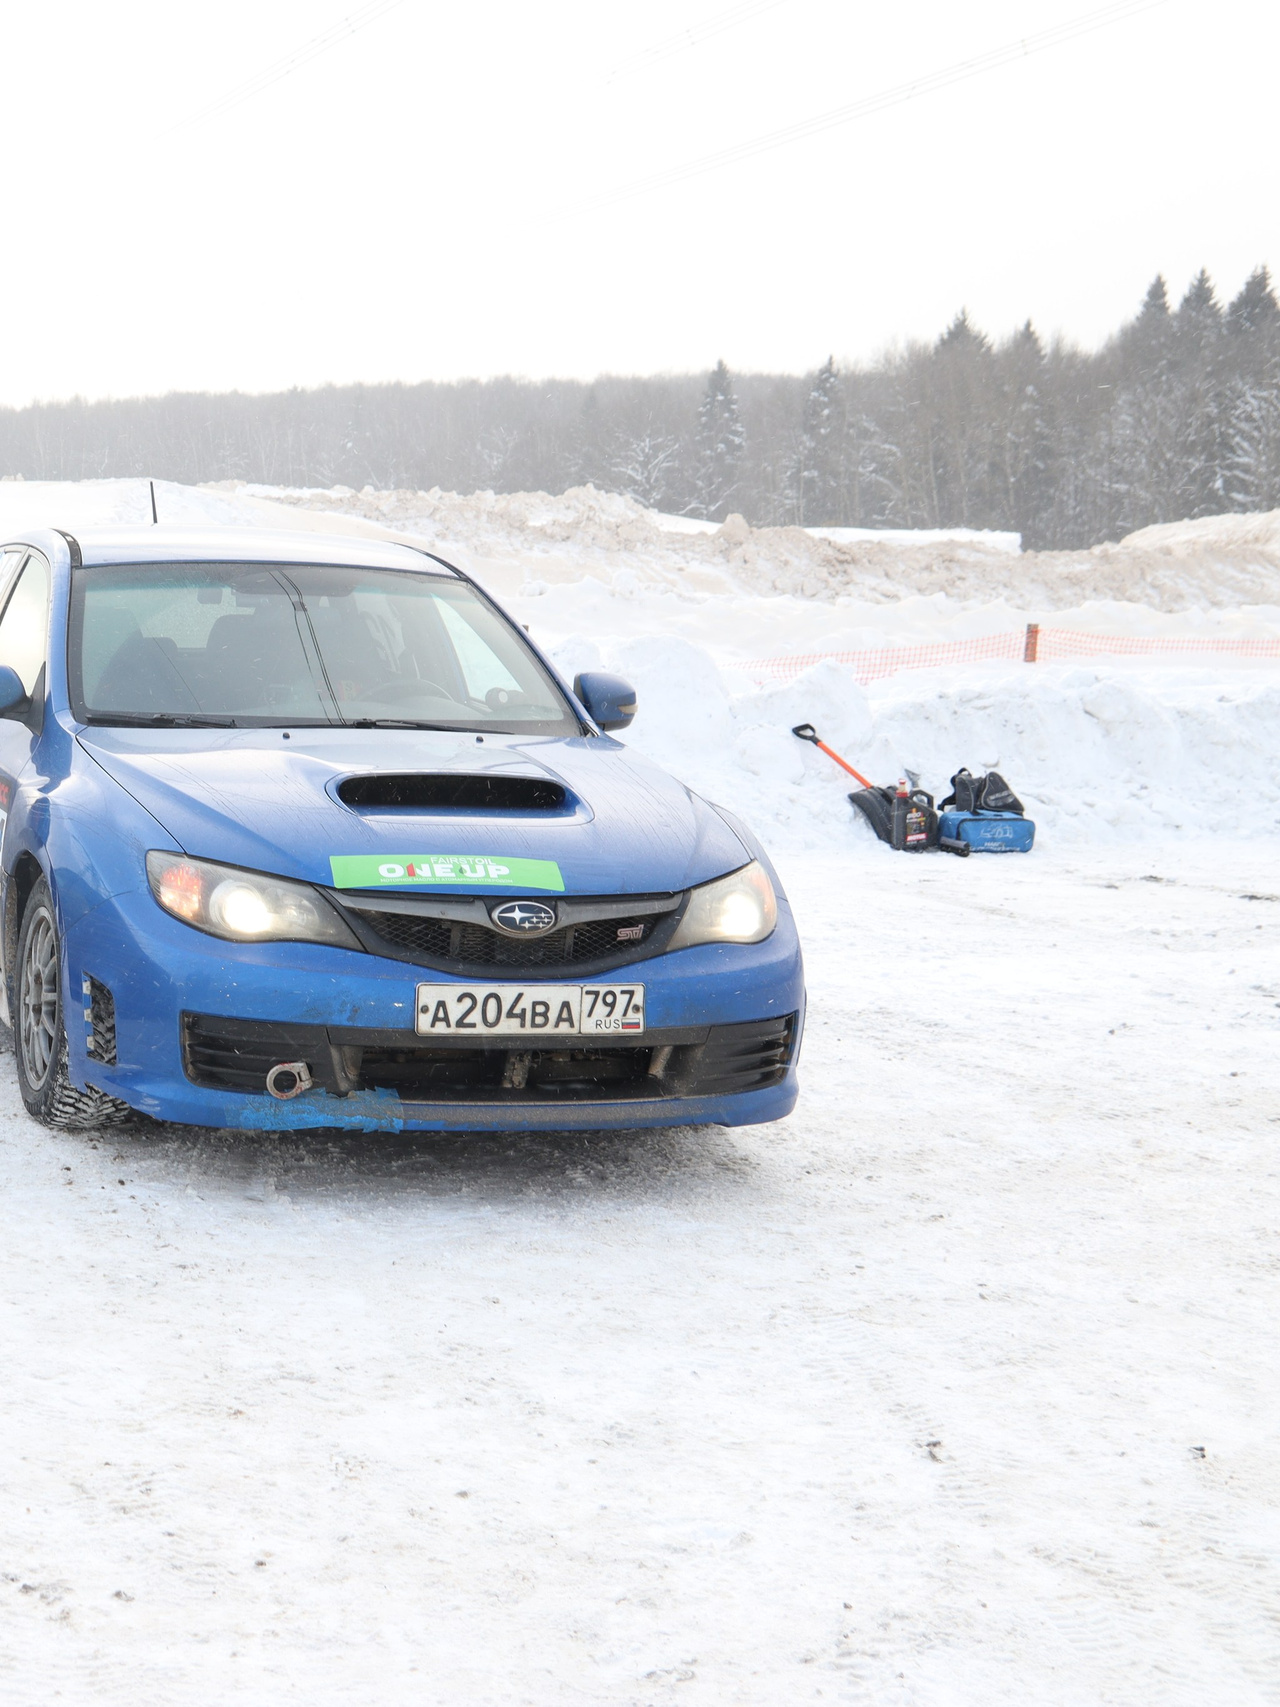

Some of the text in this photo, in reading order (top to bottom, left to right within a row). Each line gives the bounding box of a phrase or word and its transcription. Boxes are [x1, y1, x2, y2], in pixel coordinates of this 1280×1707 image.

[378, 862, 510, 879] ONE UP
[584, 990, 635, 1018] 797
[595, 1019, 620, 1030] RUS
